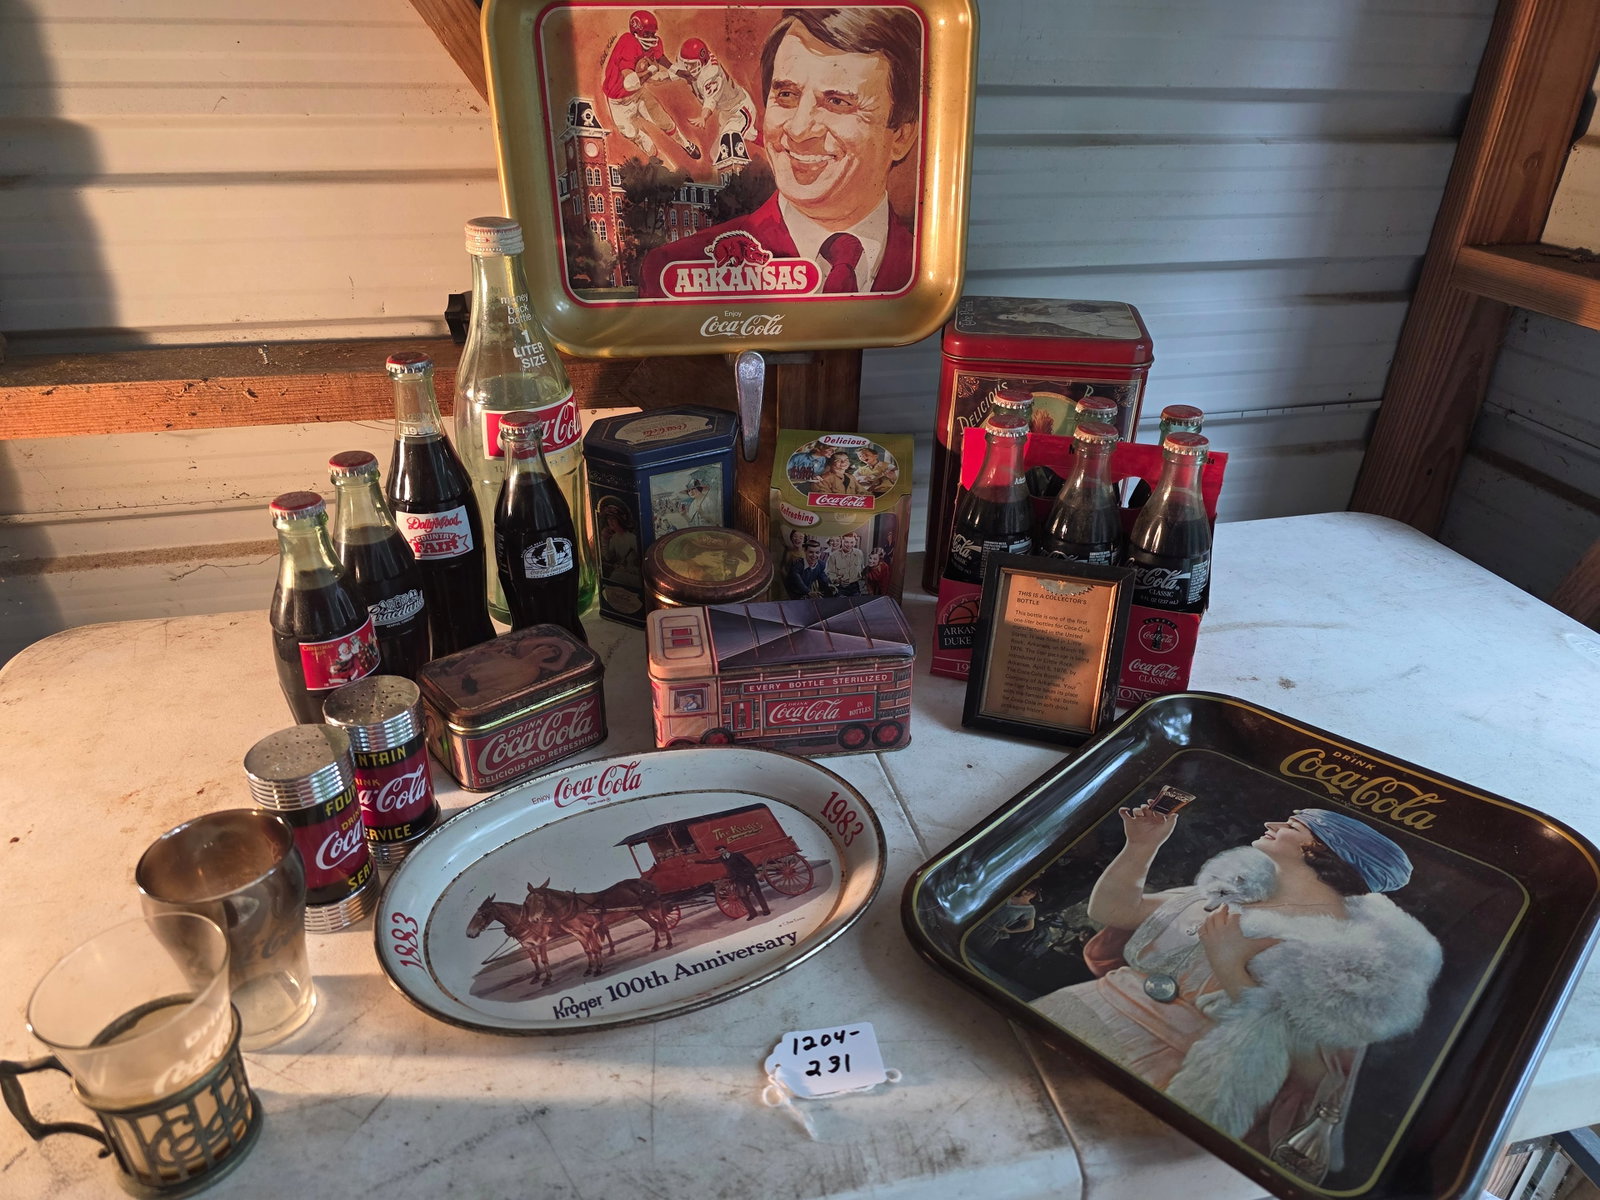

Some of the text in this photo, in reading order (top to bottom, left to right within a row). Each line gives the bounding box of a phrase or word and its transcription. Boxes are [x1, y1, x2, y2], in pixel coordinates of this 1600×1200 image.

[675, 265, 807, 293] ARKANSAS
[508, 312, 532, 325] bottle
[700, 314, 785, 337] Coca-Cola
[724, 311, 742, 322] Enjoy
[521, 329, 531, 344] 1
[513, 341, 545, 358] LITER
[521, 354, 547, 370] SIZE
[823, 436, 867, 446] Delicious
[816, 494, 866, 507] Coca-Cola
[780, 503, 814, 524] Refreshing
[413, 540, 459, 553] FAIR
[415, 533, 455, 543] COUNTRY
[1017, 597, 1040, 605] BOTTLE
[1045, 594, 1087, 605] COLLECTOR'S
[944, 636, 972, 646] DUKE
[1129, 659, 1180, 680] Coca-Cola
[749, 674, 888, 692] EVERY BOTTLE STERILIZED
[1138, 675, 1170, 686] CLASSIC
[769, 699, 844, 724] Coca-Cola
[848, 706, 872, 717] BOTTLES
[508, 716, 543, 737] DRINK
[477, 698, 595, 775] Coca-Cola
[479, 732, 599, 785] DELICIOUS AND REFRESHING
[1332, 751, 1375, 772] DRINK
[554, 759, 642, 808] Coca-Cola
[1279, 748, 1447, 830] Coca-Cola
[531, 793, 550, 805] Enjoy
[821, 791, 864, 847] 1983
[391, 912, 425, 970] 1883
[553, 929, 799, 1020] Kroger 100th Anniversary
[793, 1030, 860, 1055] 1204-
[805, 1054, 850, 1077] 231
